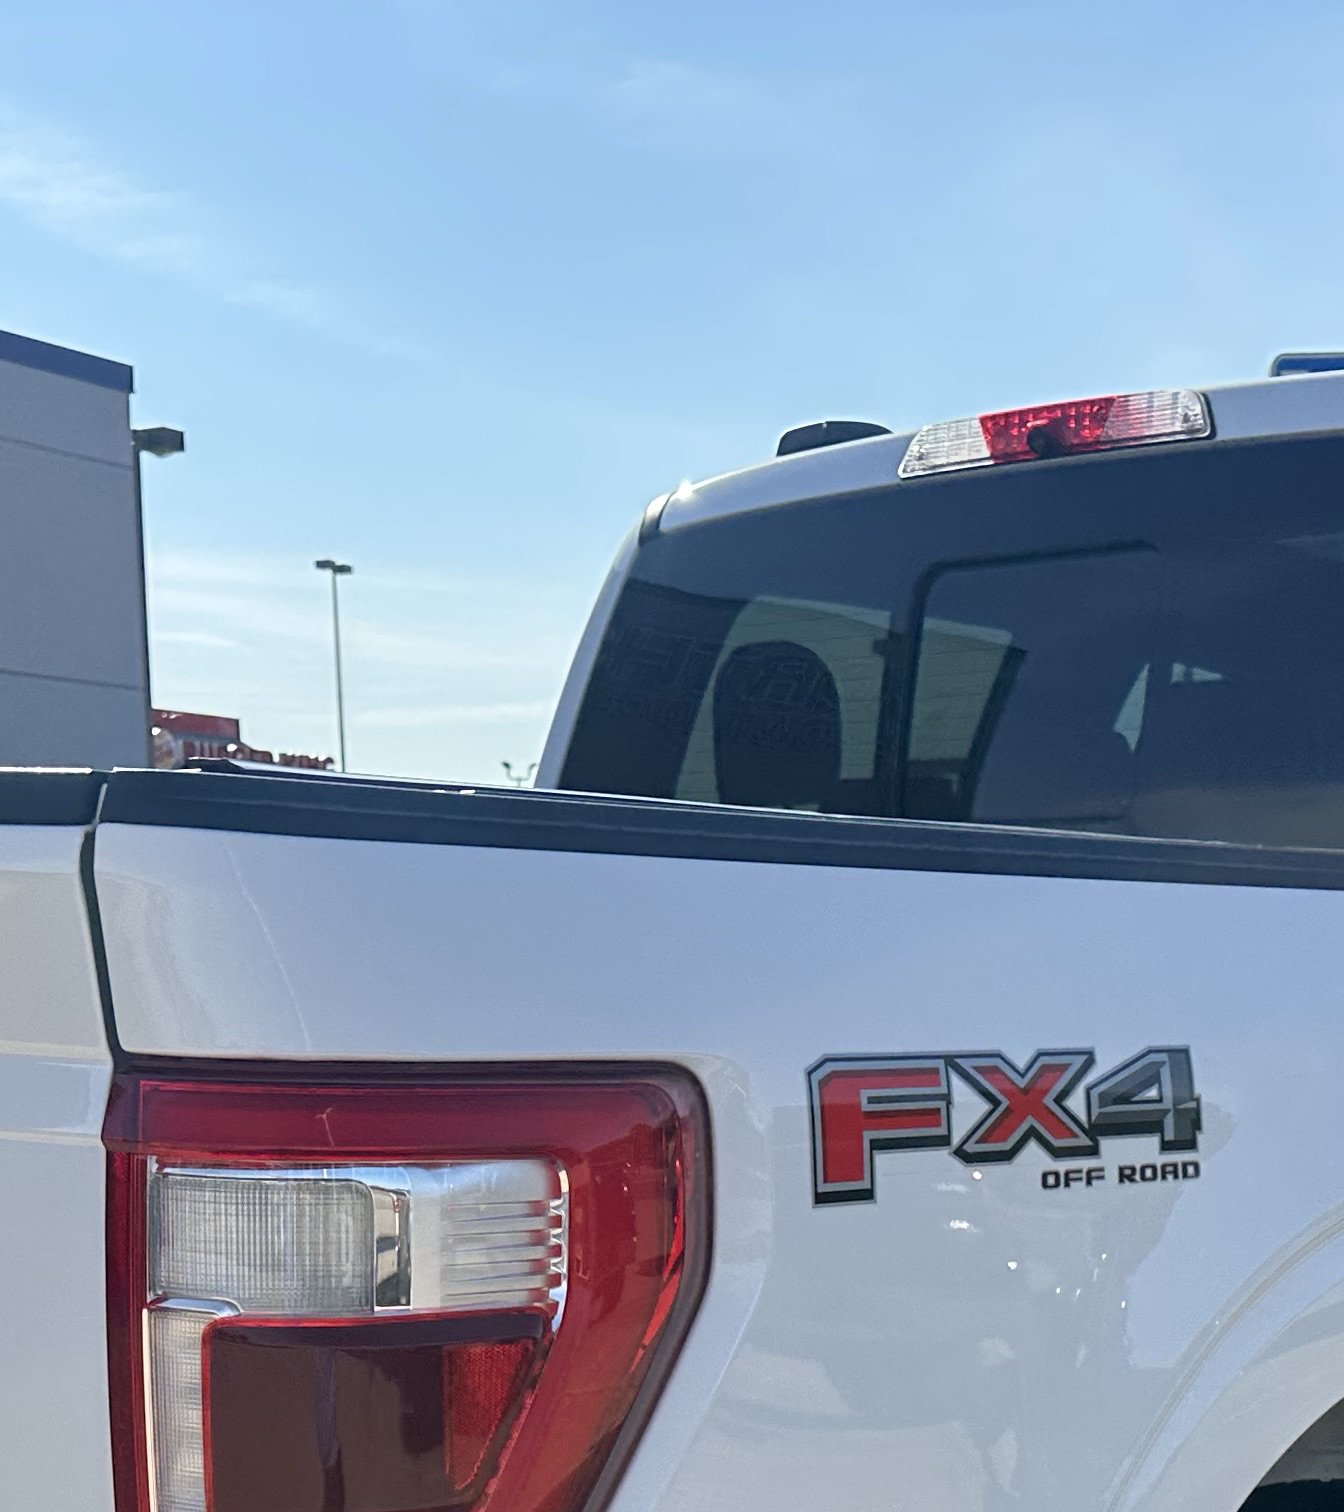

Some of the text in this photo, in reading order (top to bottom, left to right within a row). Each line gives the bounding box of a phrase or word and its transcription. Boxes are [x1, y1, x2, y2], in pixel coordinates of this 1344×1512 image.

[804, 1045, 1203, 1208] FX4
[1041, 1160, 1202, 1190] OFF ROAD
